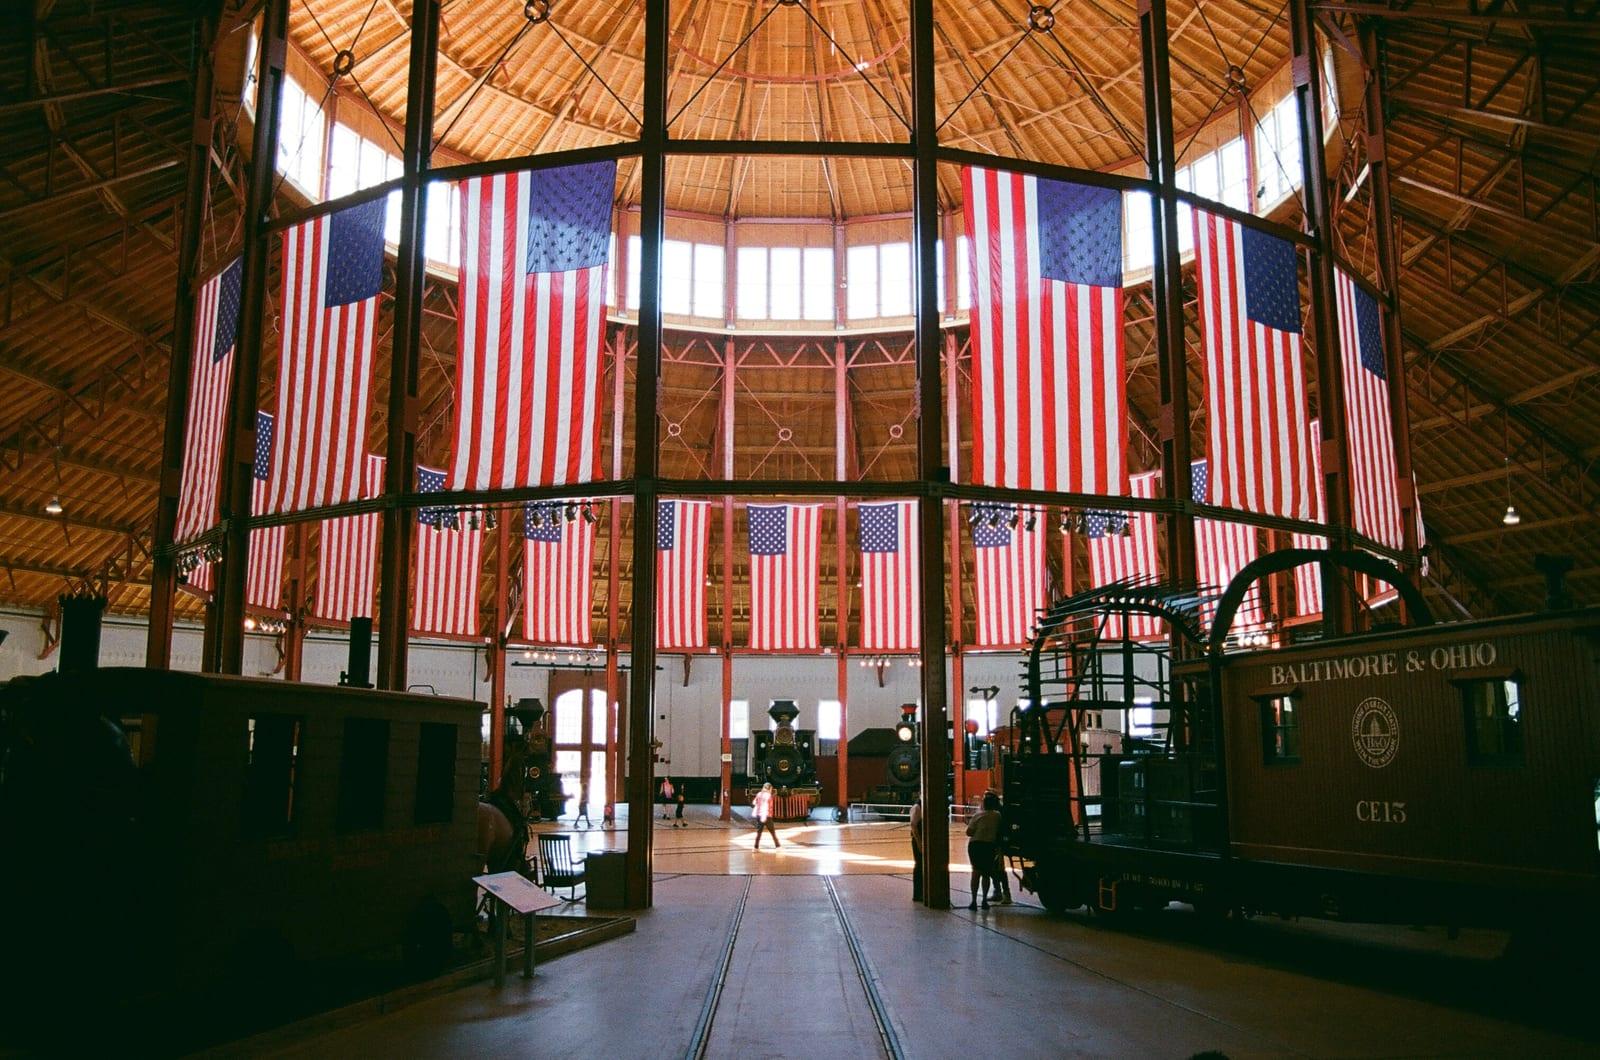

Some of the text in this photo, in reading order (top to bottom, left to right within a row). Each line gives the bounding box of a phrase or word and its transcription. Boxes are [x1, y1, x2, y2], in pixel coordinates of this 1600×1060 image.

[1271, 642, 1497, 685] BALTIMORE & OHIO
[1356, 800, 1407, 823] CE15
